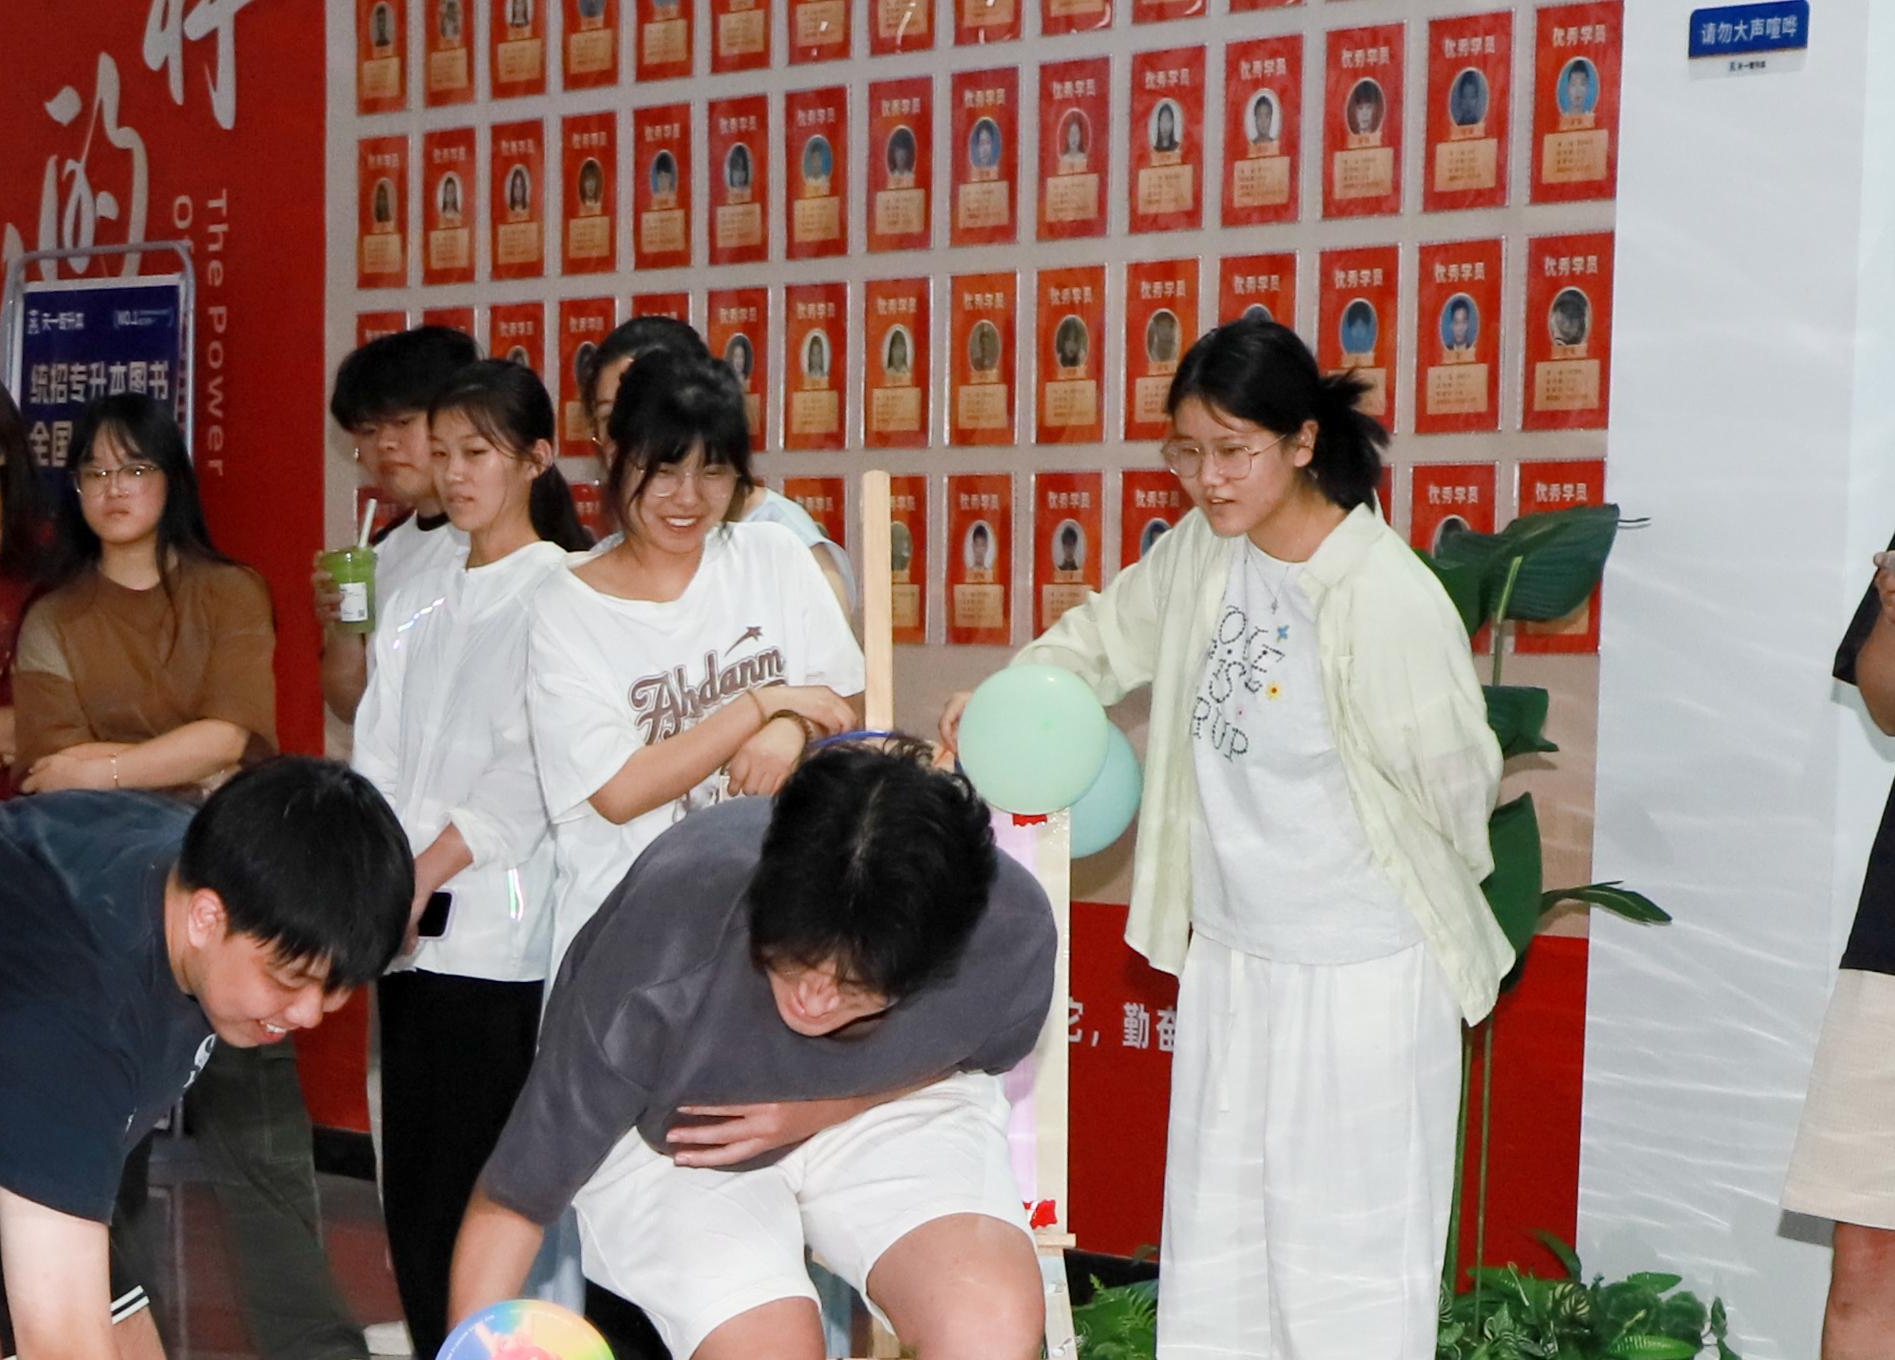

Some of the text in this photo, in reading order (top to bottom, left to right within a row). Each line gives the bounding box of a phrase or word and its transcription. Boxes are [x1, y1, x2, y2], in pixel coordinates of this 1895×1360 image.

[1553, 24, 1606, 48] 优秀学员
[1701, 14, 1798, 45] 请勿大声喧哗
[1341, 47, 1390, 69] 优秀学员
[1443, 36, 1495, 59] 优秀学员
[1145, 68, 1190, 90] 优秀学员
[1240, 58, 1286, 81] 优秀学员
[1053, 79, 1096, 100] 优秀学员
[207, 188, 229, 287] The
[1434, 262, 1485, 284] 优秀学员
[1544, 256, 1598, 277] 优秀学员
[1233, 275, 1280, 295] 优秀学员
[1333, 268, 1383, 289] 优秀学员
[1050, 286, 1093, 306] 优秀学员
[1140, 280, 1186, 299] 优秀学员
[30, 360, 169, 404] 统招专升本图书
[30, 420, 72, 468] 全国
[1047, 491, 1090, 509] 优秀学员
[1135, 490, 1180, 508] 优秀学员
[1428, 484, 1479, 504] 优秀学员
[1535, 482, 1588, 503] 优秀学员
